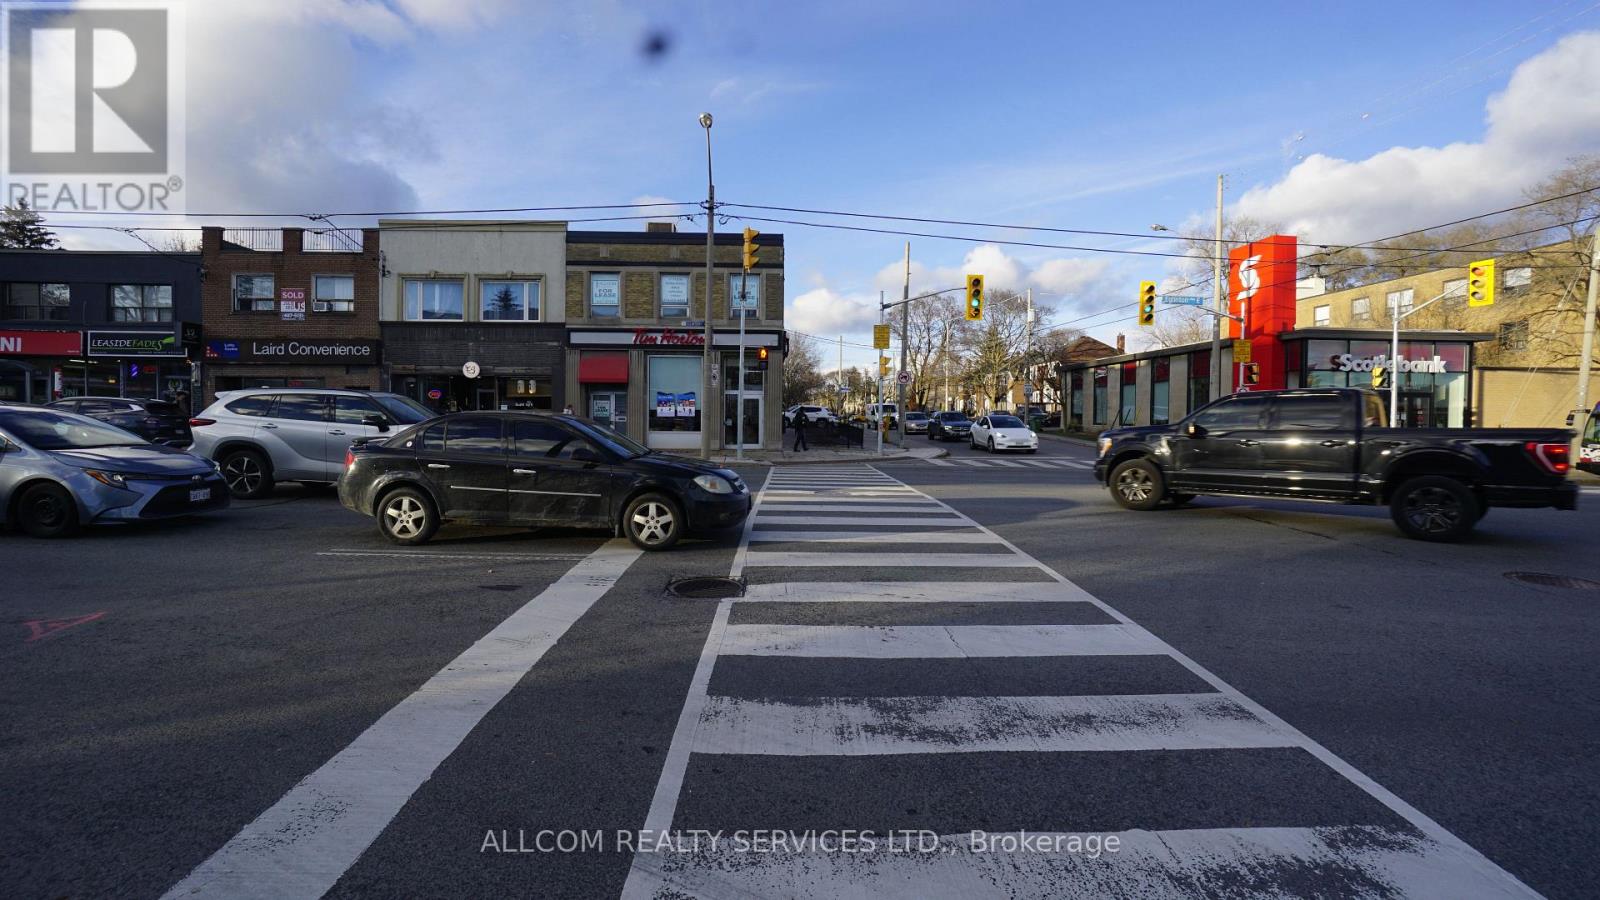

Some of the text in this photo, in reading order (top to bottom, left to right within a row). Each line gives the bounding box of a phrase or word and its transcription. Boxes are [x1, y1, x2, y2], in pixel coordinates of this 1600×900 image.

[282, 291, 304, 299] SOLD
[632, 327, 705, 345] Tim Horton
[253, 342, 284, 355] Laird
[288, 342, 370, 356] Convenience
[1339, 353, 1447, 373] Scotiabank
